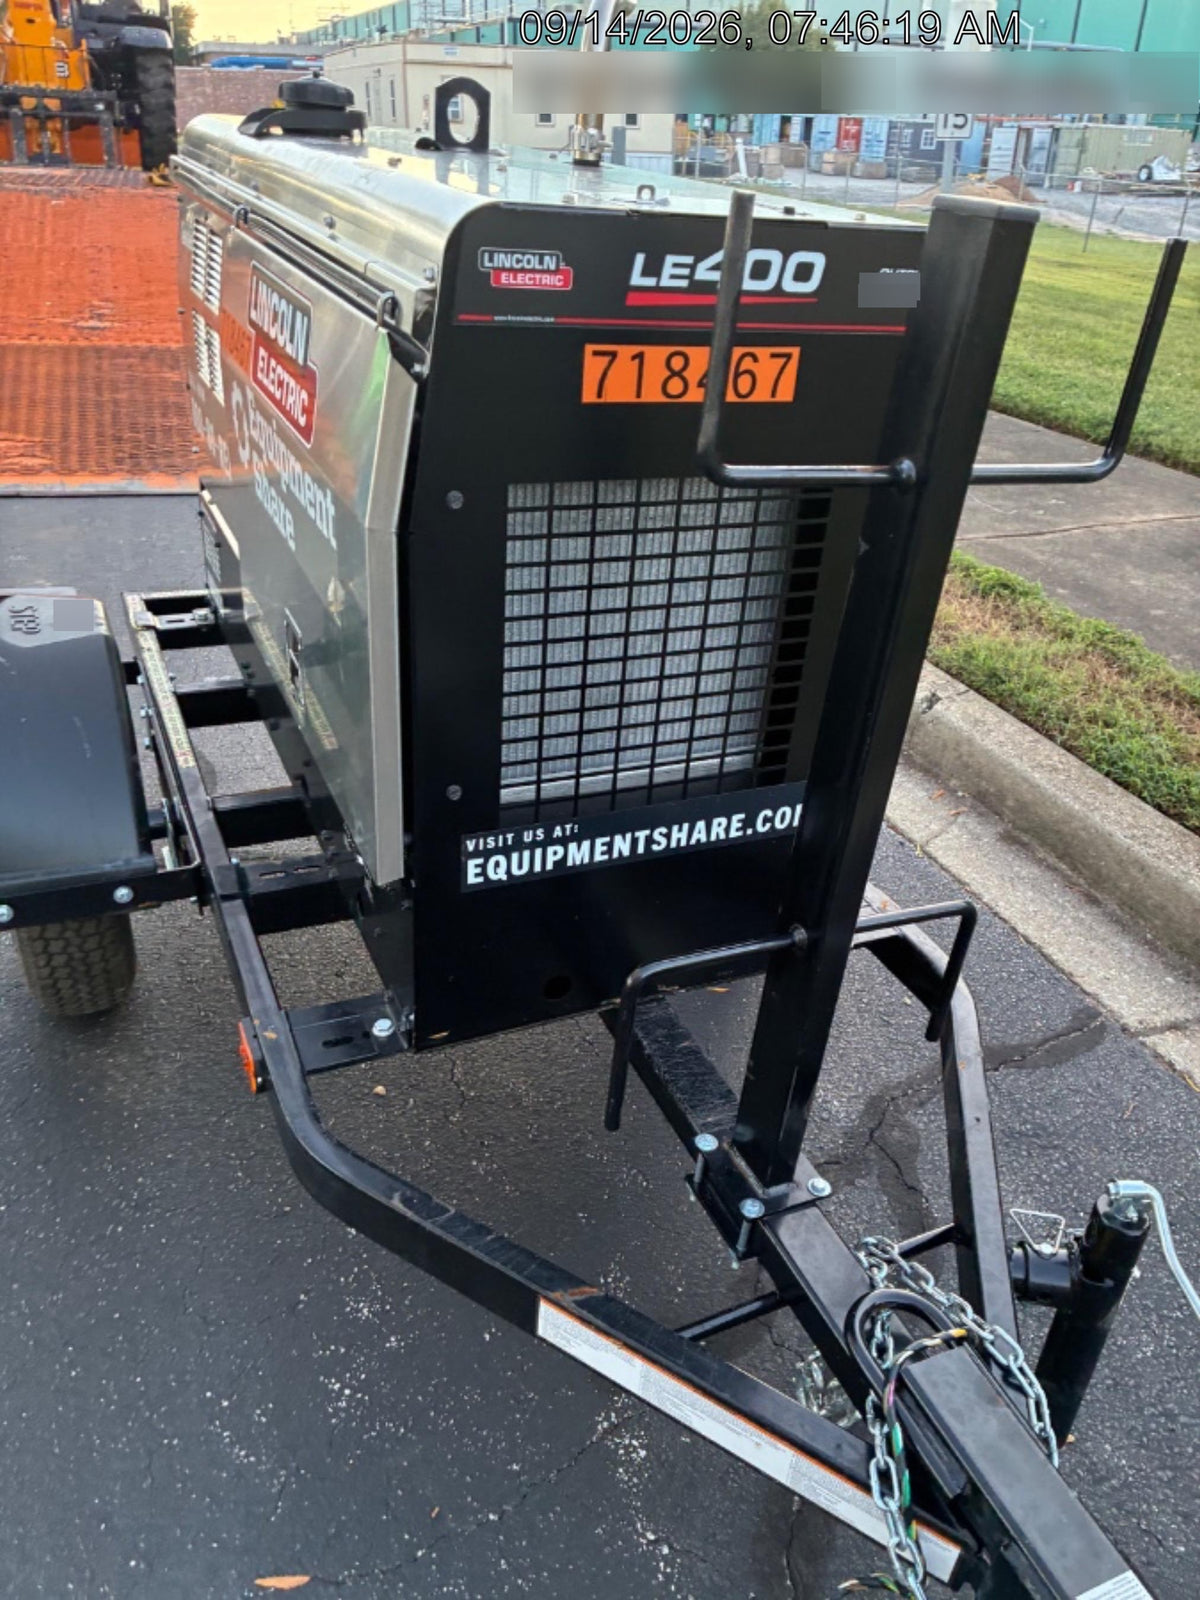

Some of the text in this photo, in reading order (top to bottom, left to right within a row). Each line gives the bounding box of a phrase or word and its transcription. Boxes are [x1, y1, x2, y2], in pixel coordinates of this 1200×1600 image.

[483, 252, 557, 270] LINCOLN
[501, 272, 565, 286] ELECTRIC
[250, 275, 308, 366] LINCOLN
[257, 346, 308, 427] ELECTRIC
[466, 823, 579, 852] VISIT US AT:
[466, 803, 803, 885] EQUIPMENTSHARE.CO
